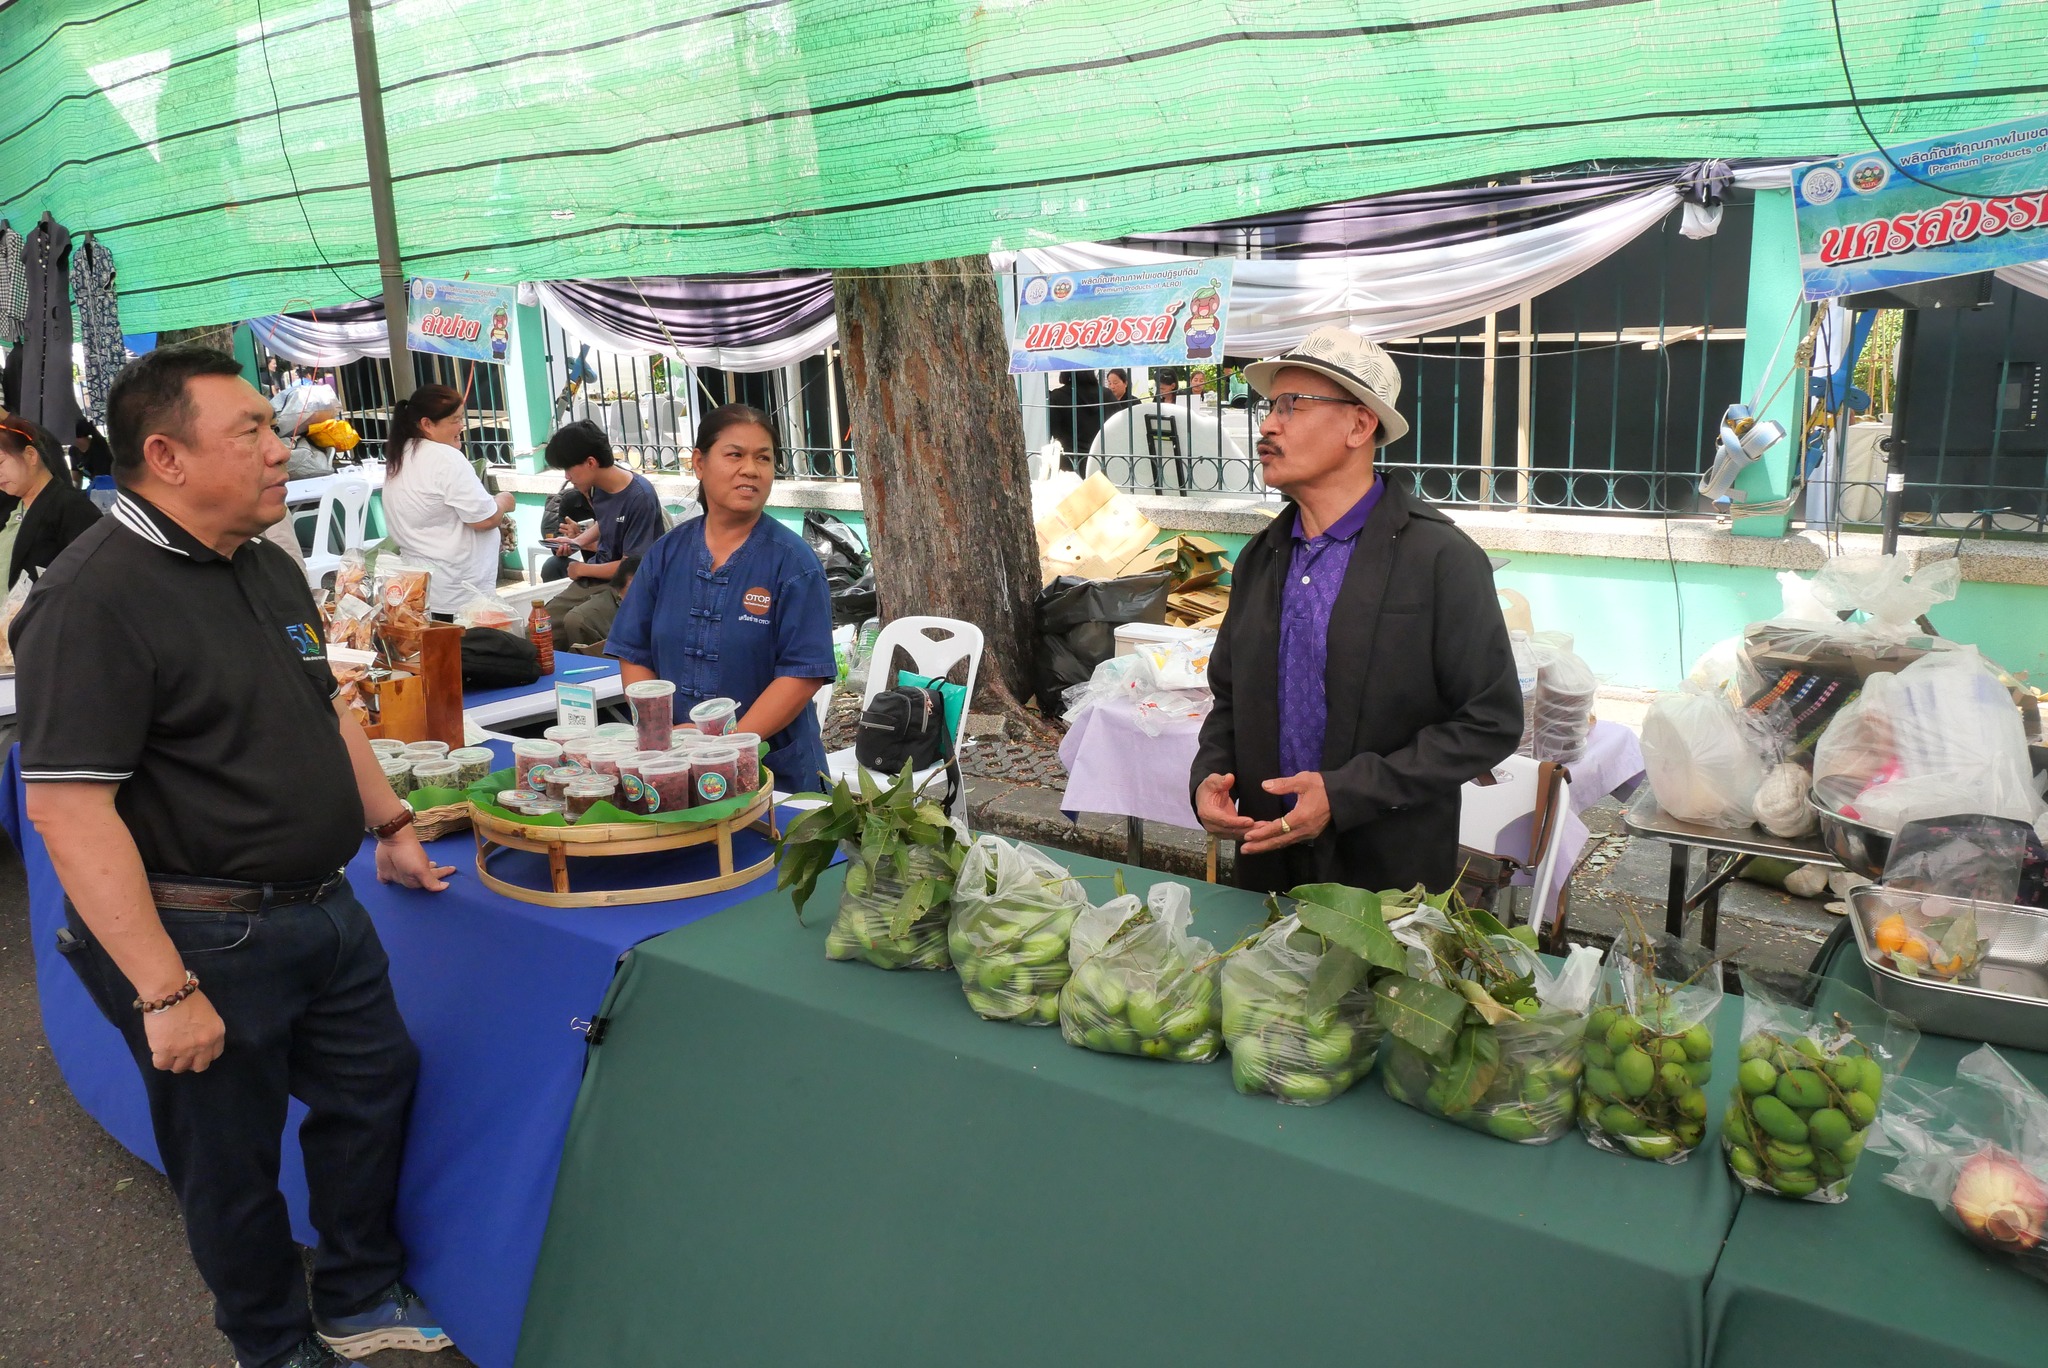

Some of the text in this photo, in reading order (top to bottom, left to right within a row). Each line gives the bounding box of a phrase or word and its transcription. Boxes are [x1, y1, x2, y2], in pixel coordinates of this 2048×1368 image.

[1928, 143, 2048, 176] (Premium Products of
[1094, 286, 1123, 295] (Premium
[1124, 284, 1152, 292] Products
[1161, 280, 1182, 288] ALRO)
[421, 307, 481, 341] ลำปาง
[1024, 300, 1185, 350] นครสวรรค์
[746, 594, 770, 603] OTOP
